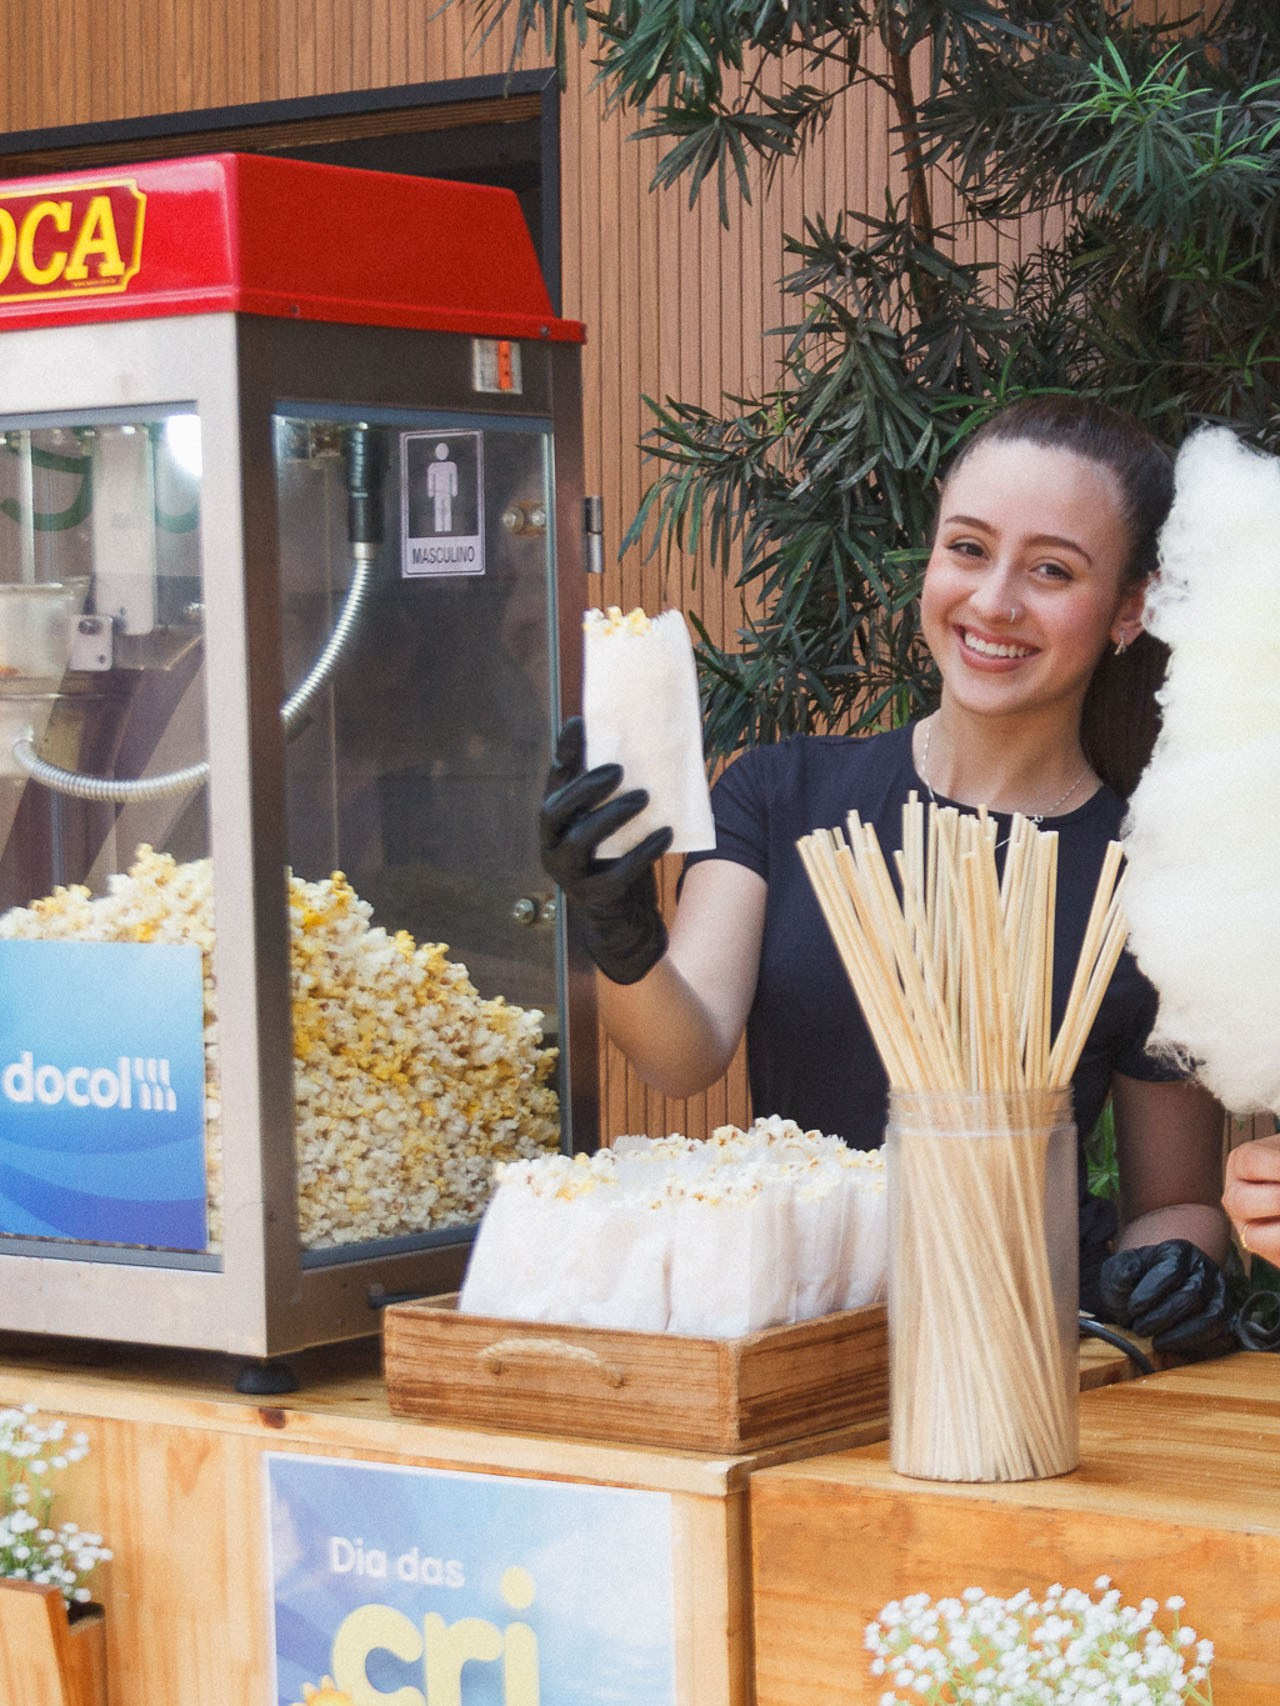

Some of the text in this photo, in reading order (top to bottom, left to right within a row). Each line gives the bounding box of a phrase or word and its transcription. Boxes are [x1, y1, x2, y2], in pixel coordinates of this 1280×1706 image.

[412, 546, 475, 564] MASCULINO
[3, 1051, 131, 1109] docol
[330, 1536, 465, 1588] Dia das
[331, 1565, 539, 1706] cri
